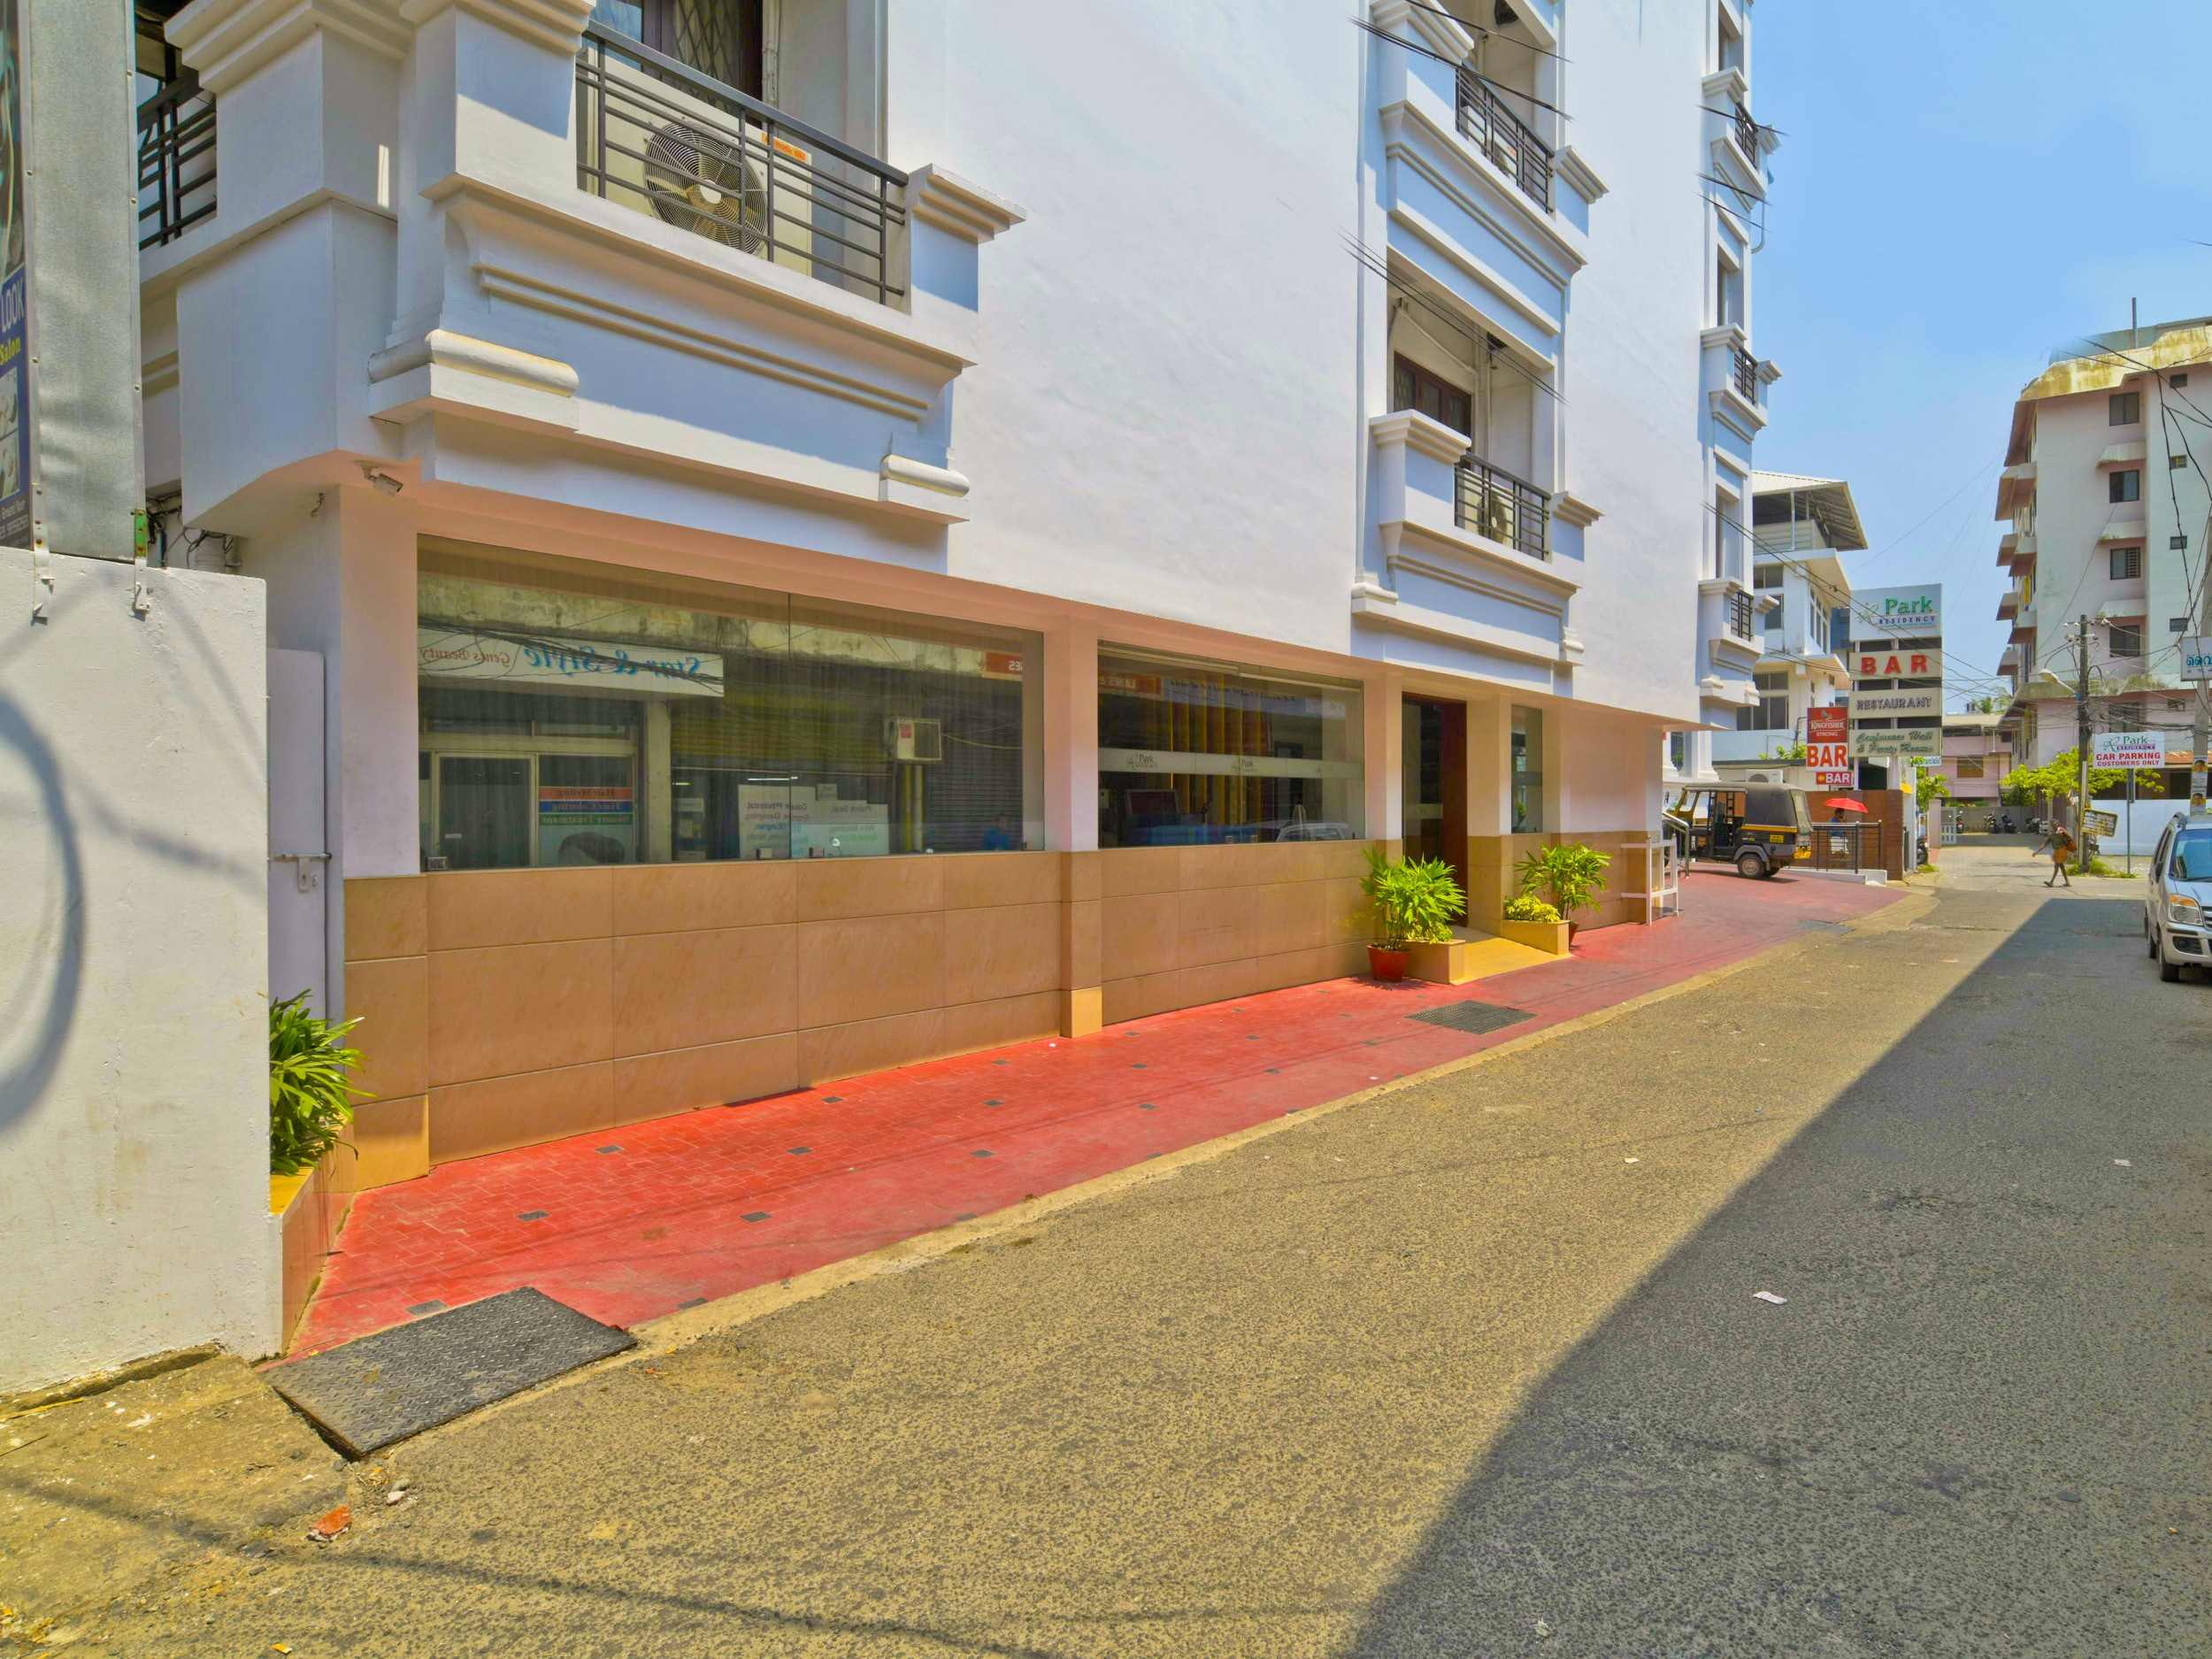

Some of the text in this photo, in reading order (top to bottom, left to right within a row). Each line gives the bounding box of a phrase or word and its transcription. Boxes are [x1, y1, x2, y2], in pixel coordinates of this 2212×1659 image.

[1886, 595, 1933, 614] Park
[1878, 615, 1936, 625] RESIDENCY
[1861, 654, 1928, 675] BAR
[1856, 697, 1932, 710] RESTAURANT
[1810, 721, 1846, 730] KINGFISHER
[2124, 735, 2147, 745] Park
[1807, 745, 1847, 768] BAR
[2119, 752, 2161, 761] PARKING
[1824, 772, 1850, 784] BAR
